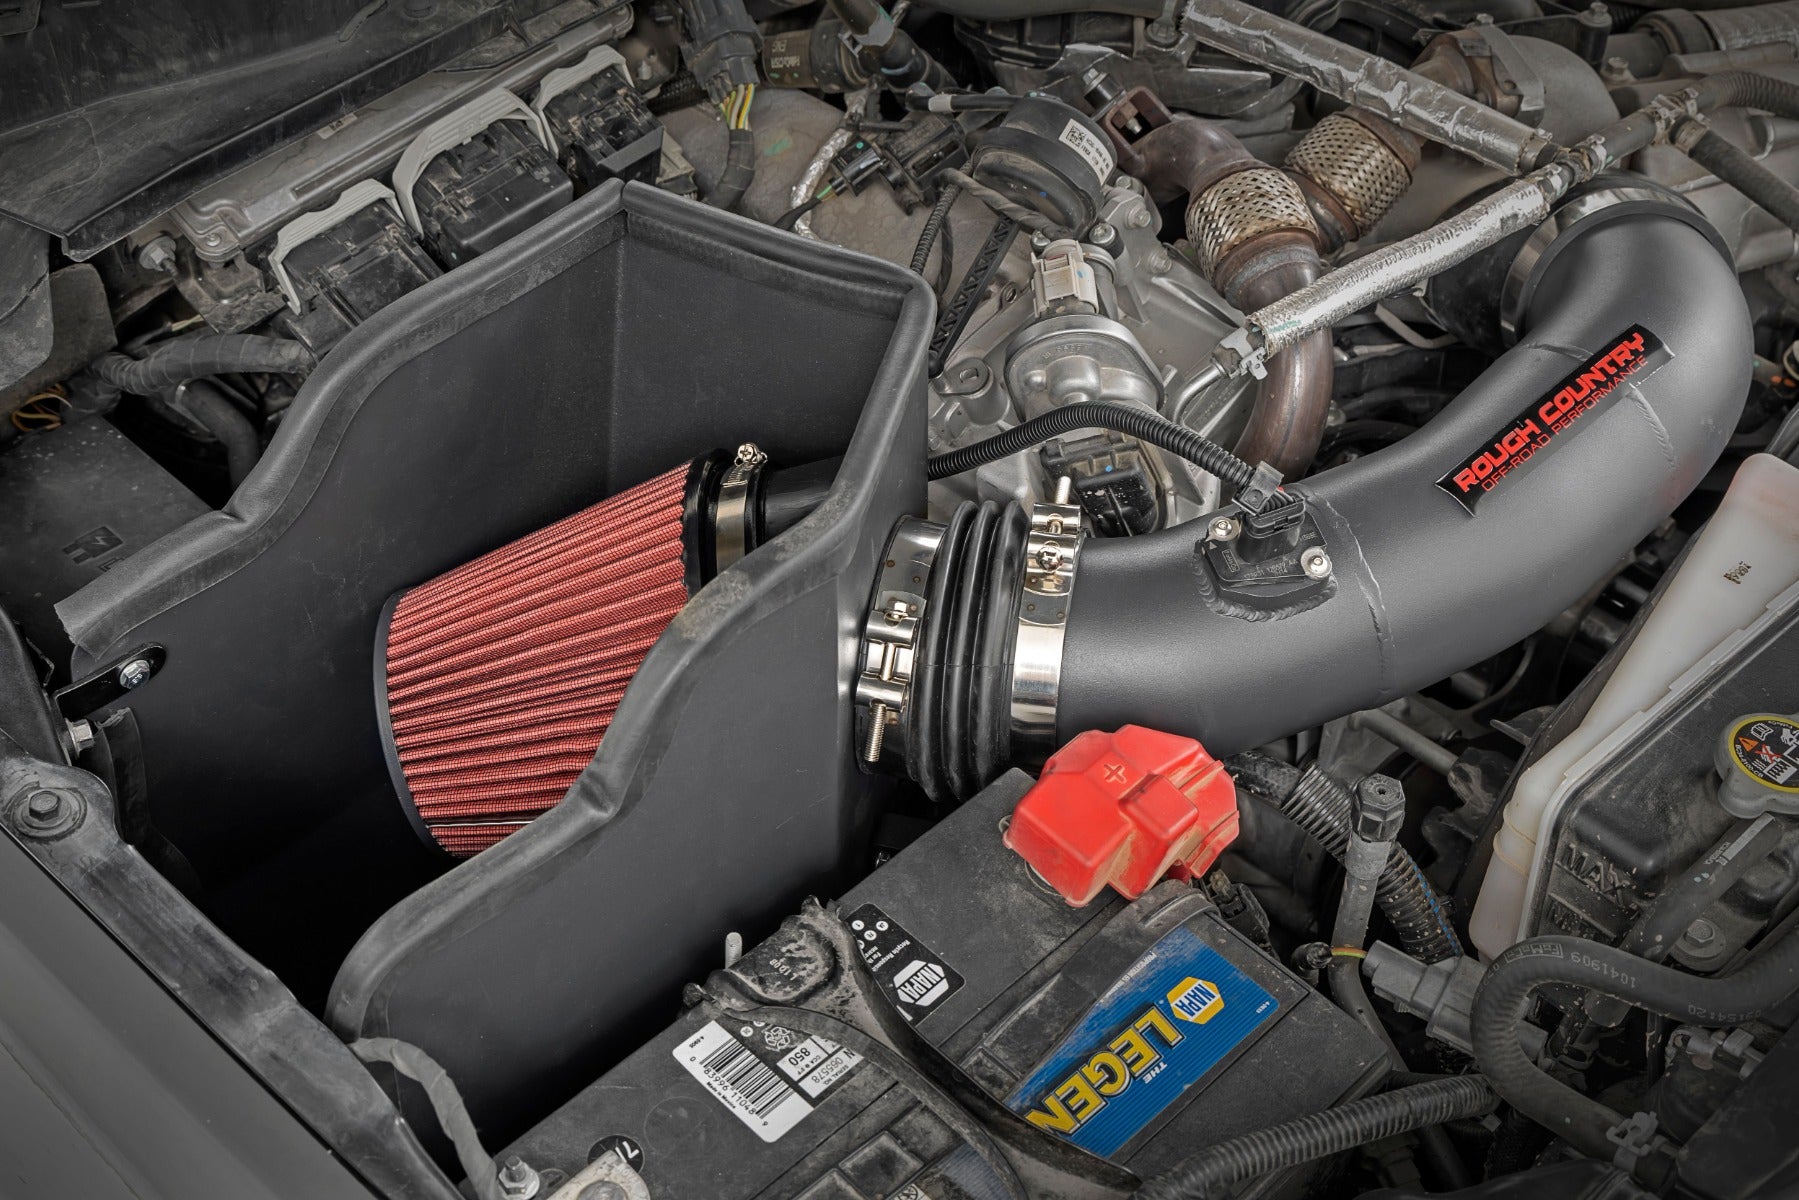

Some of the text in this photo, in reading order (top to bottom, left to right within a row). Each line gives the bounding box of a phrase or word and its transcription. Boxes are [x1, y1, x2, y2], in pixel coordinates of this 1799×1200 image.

[1452, 330, 1648, 492] ROUGH COUNTRY
[1480, 354, 1648, 492] OFF-ROAD PERFORMANCE
[1558, 841, 1630, 907] MAX
[899, 964, 940, 1002] NAPA
[1568, 950, 1636, 988] 1041909
[1173, 982, 1215, 1019] NAPA
[787, 1045, 810, 1067] 850
[831, 1063, 849, 1079] SERIAL
[1141, 1060, 1168, 1084] THE
[703, 1066, 729, 1092] 83996
[730, 1091, 756, 1116] 11048
